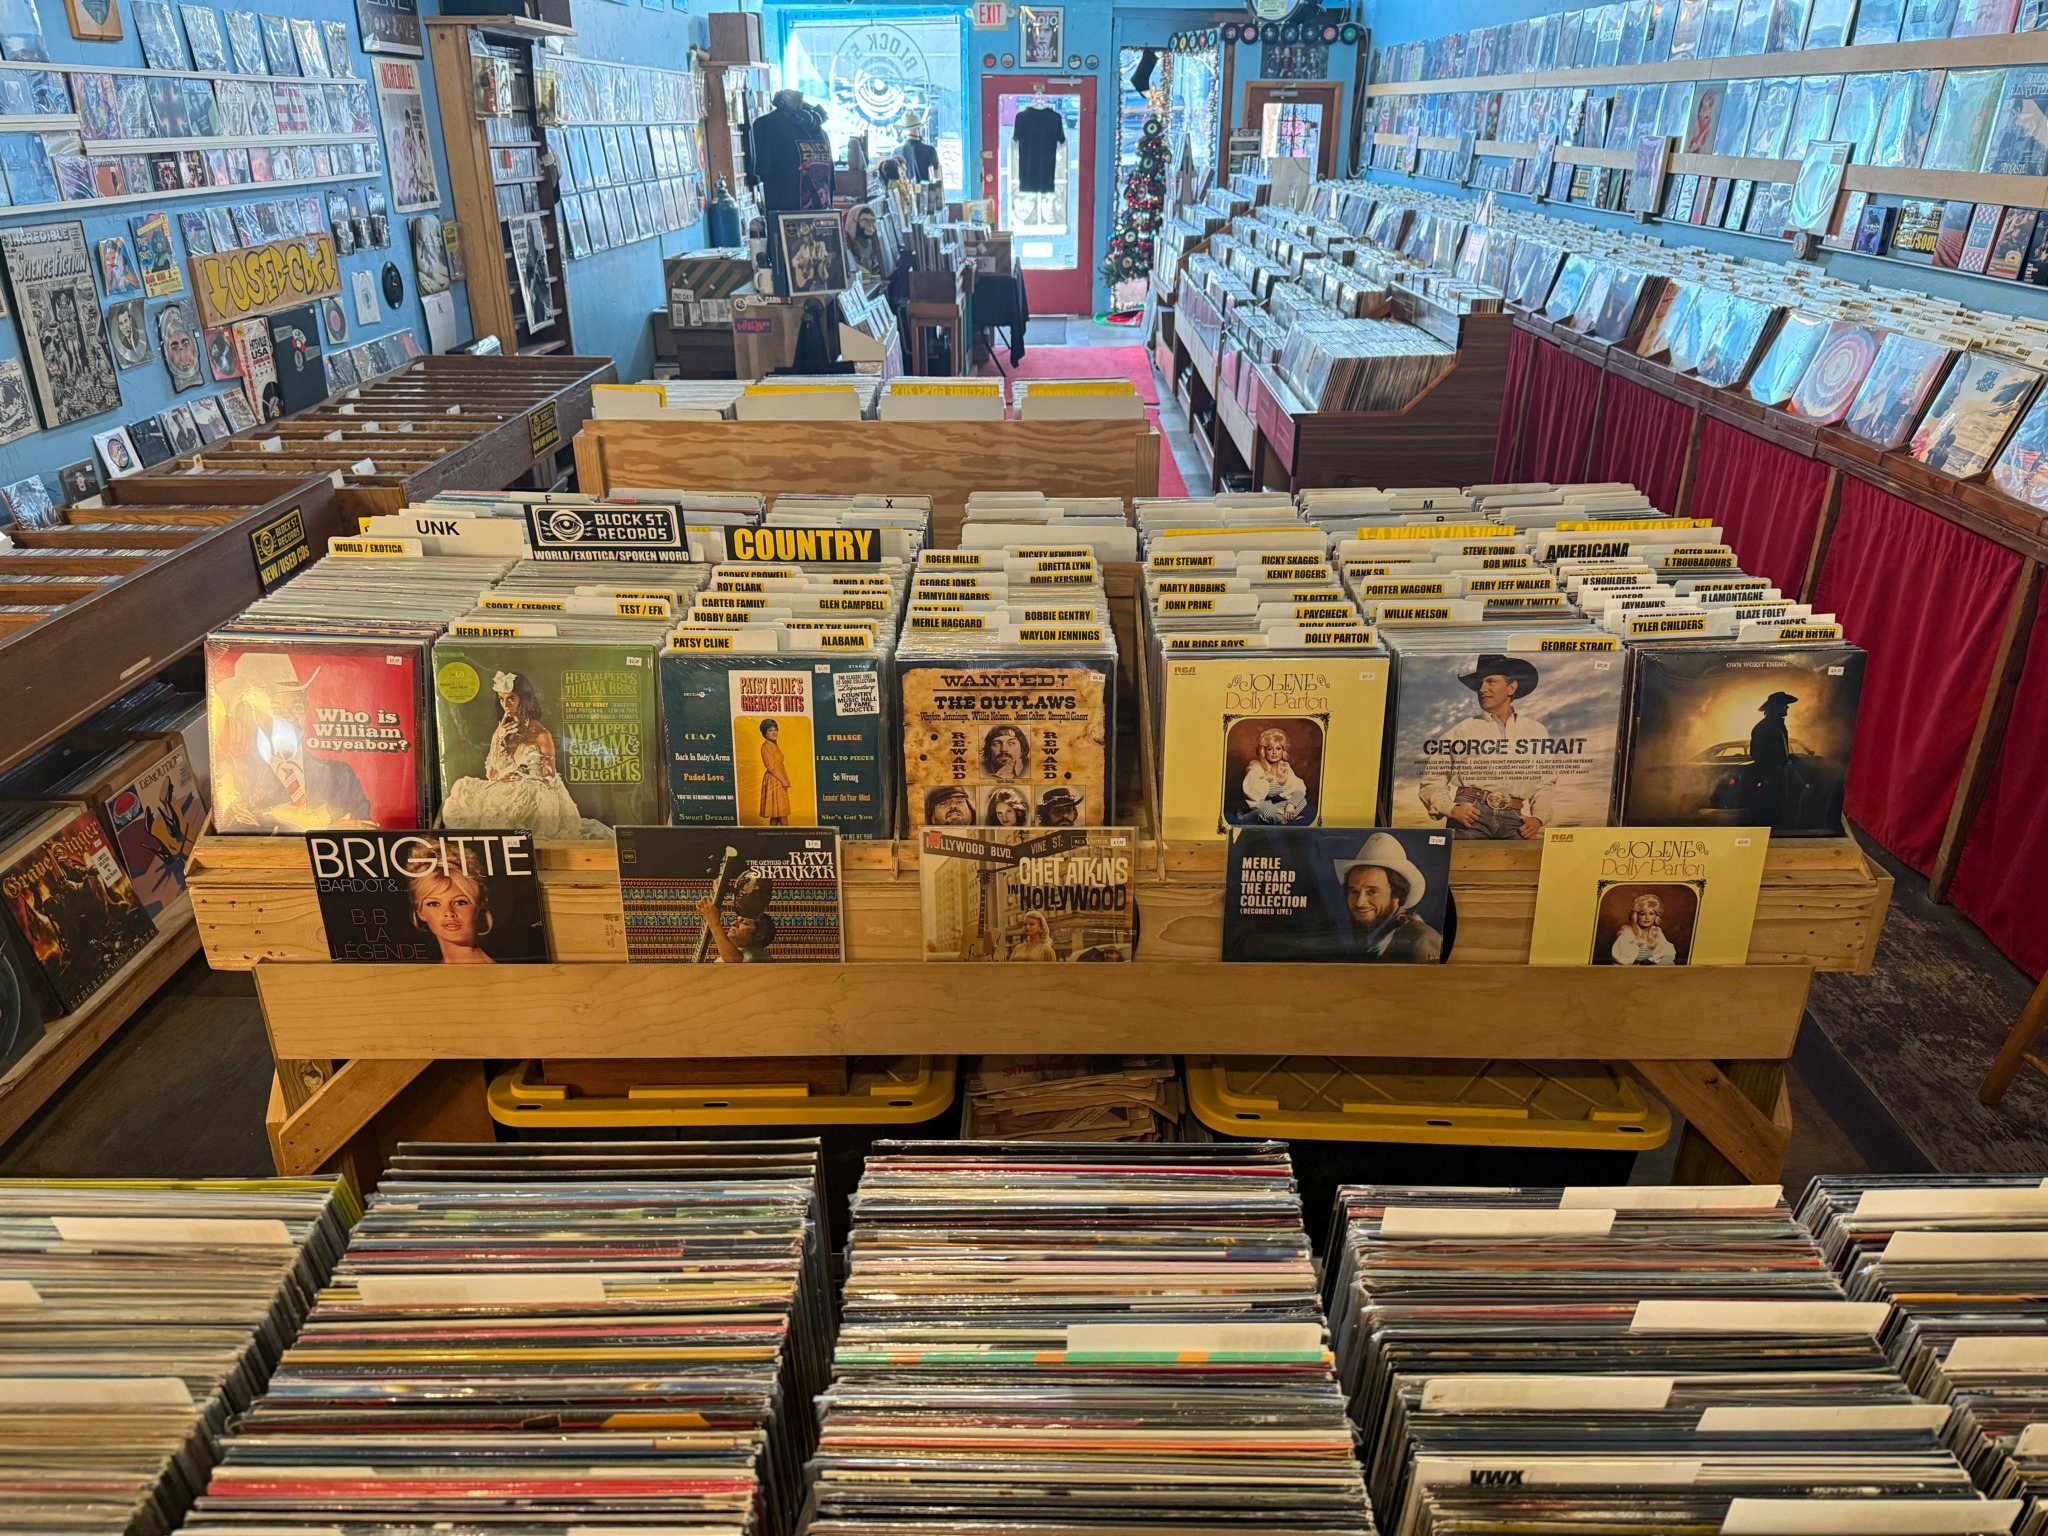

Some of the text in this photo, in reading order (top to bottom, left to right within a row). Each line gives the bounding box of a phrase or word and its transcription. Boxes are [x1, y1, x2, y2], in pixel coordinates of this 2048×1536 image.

[979, 4, 1002, 24] EXIT
[379, 62, 416, 91] INCREDIBLE!
[9, 228, 70, 246] INCREDIBLE
[16, 246, 87, 283] SCIENCE FICTION
[251, 349, 269, 360] USA
[885, 499, 894, 508] X
[1422, 500, 1434, 510] M
[594, 513, 668, 527] BLOCK ST.
[274, 518, 300, 538] BLOCK ST.
[415, 518, 461, 536] UNK
[277, 526, 301, 547] RECORDS
[597, 526, 668, 541] RECORDS
[733, 528, 873, 561] COUNTRY
[533, 549, 690, 562] WORLD/EXOTICA/SPOKEN WORD
[1462, 546, 1516, 556] STEVE YOUNG
[1546, 543, 1630, 560] AMERICANA
[925, 554, 979, 564] ROGER MILLER
[1153, 556, 1213, 566] GARY STEWART
[1261, 556, 1319, 565] RICKY SKAGGS
[1482, 558, 1527, 569] BOB WILLS
[1664, 558, 1732, 567] T. TROUBADOURS
[1038, 561, 1091, 571] LORETTA LYNN
[1267, 569, 1327, 579] KENNY ROGERS
[717, 582, 762, 592] ROY CLARK
[919, 578, 976, 587] GEORGE JONES
[1159, 583, 1226, 593] MARTY ROBBINS
[1470, 579, 1551, 590] JERRY JEFF WALKER
[1366, 584, 1443, 595] PORTER WAGONER
[918, 591, 990, 600] EMMYLOU HARRIS
[1700, 592, 1764, 602] R LAMONTAGNE
[702, 598, 766, 608] CARTER FAMILY
[819, 599, 885, 610] GLEN CAMPBELL
[1164, 600, 1213, 610] JOHN PRINE
[1487, 598, 1517, 606] CONWAY
[1621, 600, 1666, 609] JAYHAWKS
[694, 612, 749, 622] BOBBY BARE
[1024, 610, 1091, 621] BOBBIE GENTRY
[1296, 608, 1349, 619] J. PAYCHECK
[1384, 608, 1448, 619] WILLIE NELSON
[1735, 608, 1787, 619] BLAZE FOLEY
[912, 618, 982, 628] MERLE HAGGARD
[1632, 619, 1704, 632] TYLER CHILDERS
[456, 627, 516, 636] HERB ALPERT
[1019, 630, 1100, 641] WAYLON JENNINGS
[1779, 628, 1836, 639] ZACH BRYAN
[673, 637, 730, 648] PATSY CLINE
[821, 636, 865, 646] ALABAMA
[1305, 633, 1370, 644] DOLLY PARTON
[1541, 641, 1613, 651] GEORGE STRAIT
[1758, 660, 1788, 668] ENEMY
[565, 671, 592, 686] HERB
[940, 674, 1069, 688] WANTED!
[1238, 673, 1318, 695] JOLENE
[739, 676, 804, 696] PATSY CLINE'S
[841, 691, 873, 699] COUNTRY
[740, 694, 805, 712] GREATEST HITS
[933, 696, 1076, 710] THE OUTLAWS
[1225, 691, 1333, 714] Dolly Parton
[314, 708, 399, 724] Who is
[312, 723, 402, 739] William
[567, 722, 639, 744] WHIPPED
[684, 733, 717, 741] CRAZY
[306, 737, 410, 751] Onyeabor?
[1422, 738, 1588, 756] GEORGE STRAIT
[675, 752, 731, 763] Back In Baby's Arms
[949, 731, 968, 780] REWARD
[1041, 731, 1060, 780] REWARD
[569, 755, 623, 768] OTHER
[569, 756, 642, 782] DELIGHTS
[683, 772, 725, 781] Faded Love
[832, 772, 859, 783] So Wrong
[679, 813, 735, 821] Sweet Dreams
[1551, 833, 1574, 841] RCA
[1616, 840, 1697, 861] JOLENE
[310, 835, 532, 879] BRIGITTE
[788, 851, 834, 866] RAVI
[1242, 857, 1282, 870] MERLE
[1600, 858, 1706, 880] Dolly Parton
[750, 864, 837, 882] SHANKAR
[1018, 856, 1129, 888] CHET ATKINS
[1241, 869, 1297, 883] HAGGARD
[1240, 882, 1292, 895] THE EPIC
[1007, 883, 1127, 912] IN HOLLYWOOD
[1239, 895, 1308, 909] COLLECTION
[1239, 907, 1293, 916] (RECORDED LIVE)
[363, 927, 392, 943] LA
[332, 940, 429, 961] LÉGENDE
